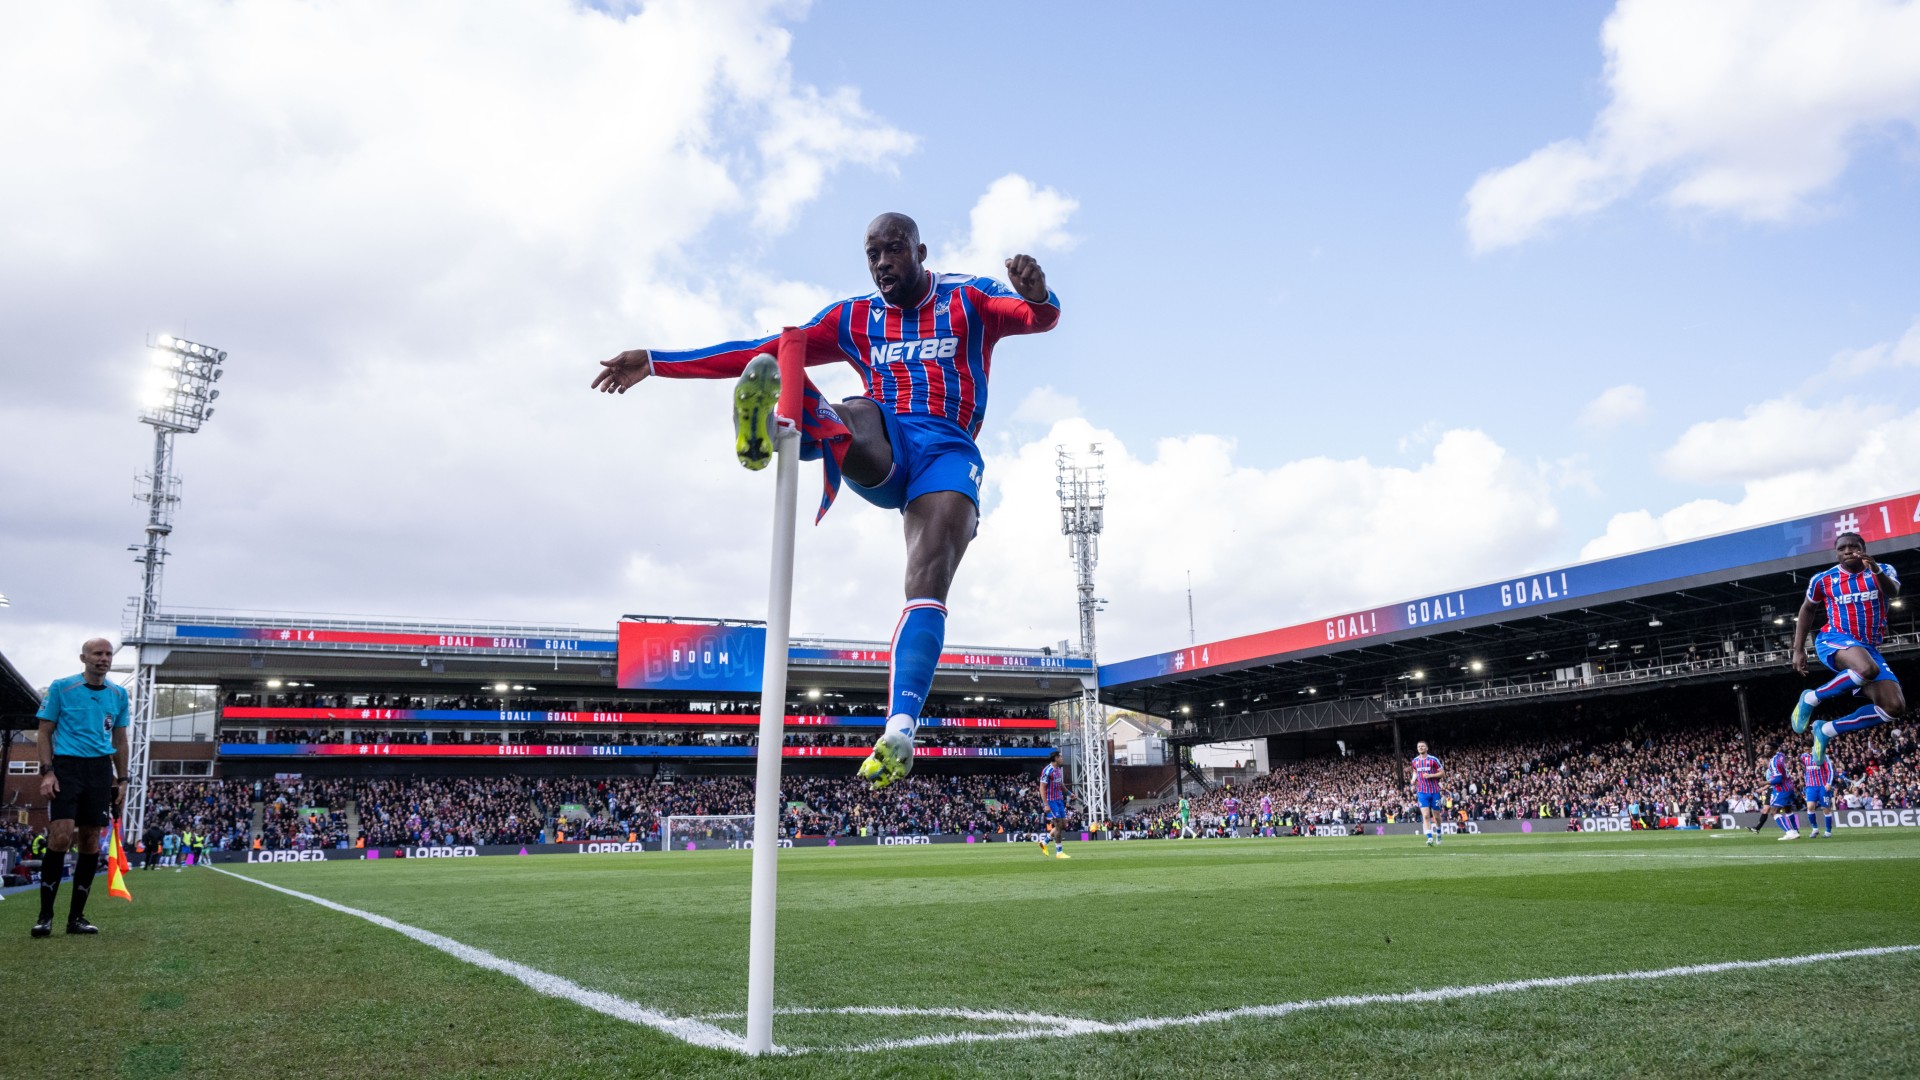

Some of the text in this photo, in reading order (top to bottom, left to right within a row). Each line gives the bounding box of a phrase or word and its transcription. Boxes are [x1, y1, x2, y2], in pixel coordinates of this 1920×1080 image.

[870, 337, 958, 367] NET88
[1326, 612, 1377, 640] GOAL!
[1407, 594, 1465, 625] GOAL!
[1501, 572, 1568, 607] GOAL!
[439, 636, 474, 647] GOAL!
[493, 637, 527, 648] GOAL!
[545, 639, 578, 650] GOAL!
[672, 649, 729, 664] BOOM
[964, 655, 990, 664] GOAL!
[1003, 656, 1028, 666] GOAL!
[1040, 658, 1065, 667] GOAL!
[500, 711, 531, 720] GOAL!
[547, 712, 577, 721] GOAL!
[593, 713, 622, 722] GOAL!
[977, 718, 1001, 727] GOAL!
[498, 745, 530, 755] GOAL!
[546, 746, 577, 755] GOAL!
[592, 746, 622, 755] GOAL!
[942, 748, 966, 756] GOAL!
[978, 748, 1002, 756] GOAL!
[247, 850, 328, 864] LOADED.
[406, 846, 479, 859] LOADED.
